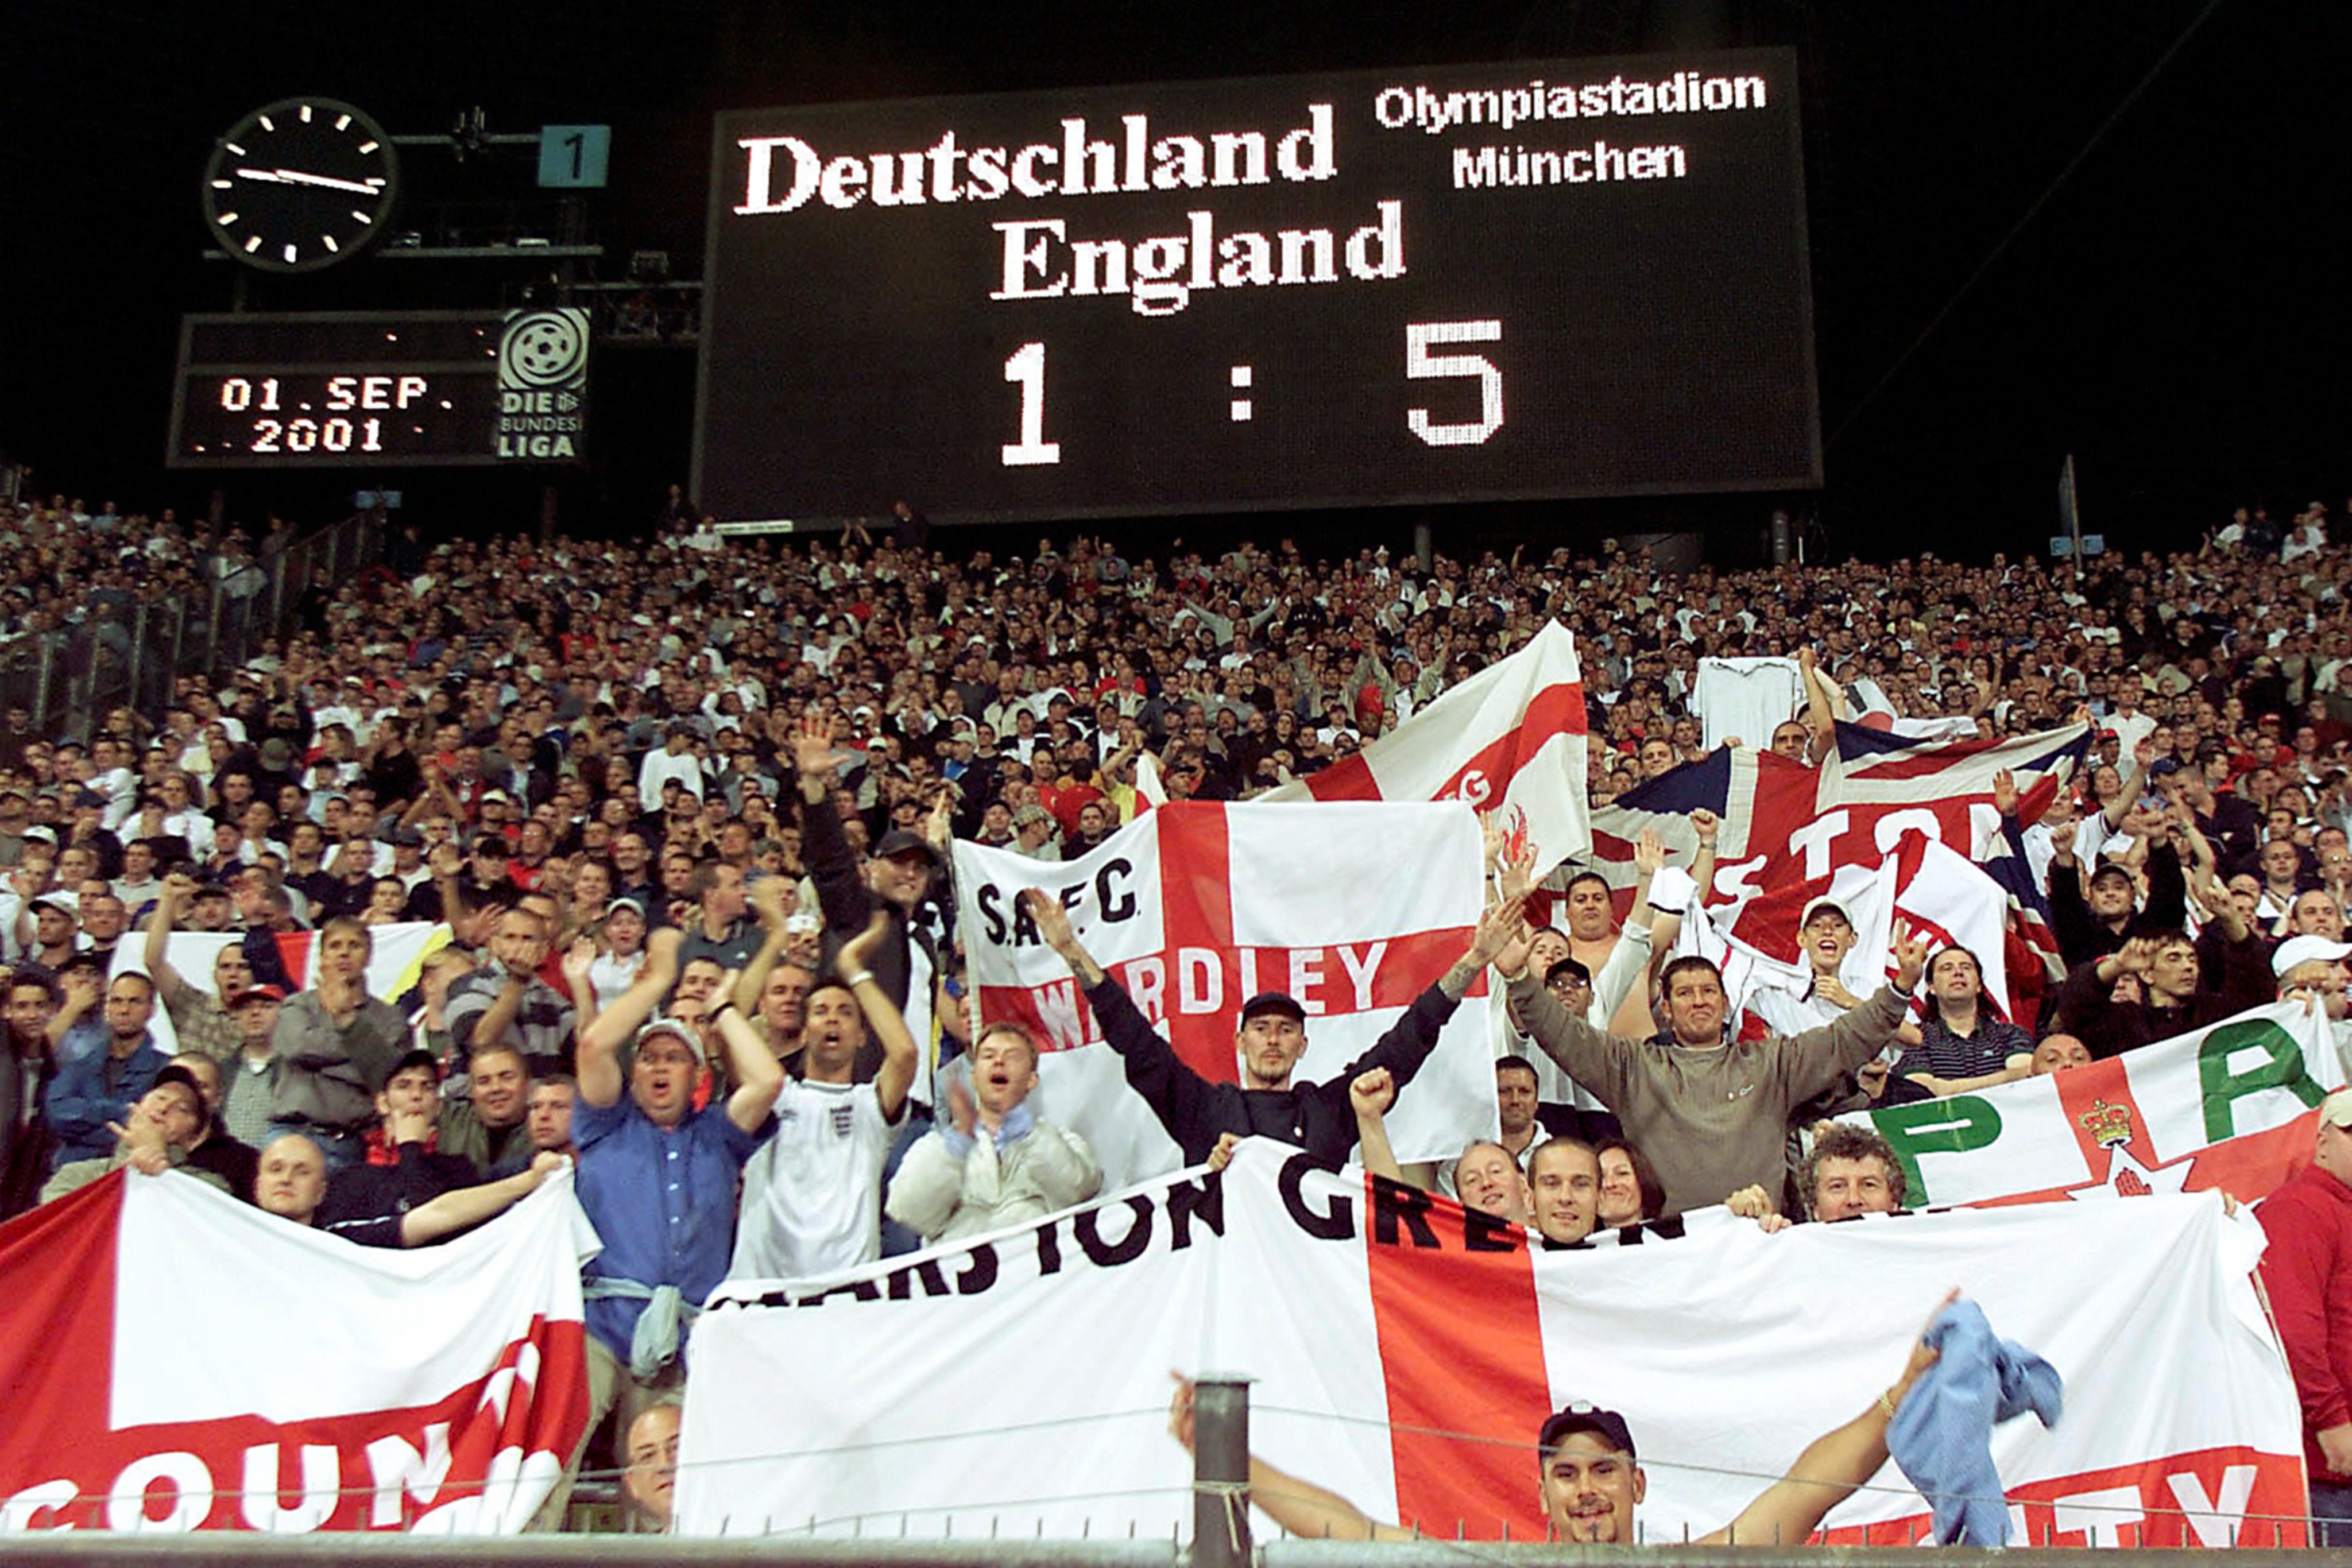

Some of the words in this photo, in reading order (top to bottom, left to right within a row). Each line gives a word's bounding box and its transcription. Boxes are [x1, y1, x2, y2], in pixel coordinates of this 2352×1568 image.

[1376, 72, 1765, 134] Olympiastadion
[565, 133, 583, 179] 1
[734, 104, 1337, 216] Deutschland
[1453, 141, 1686, 188] München
[991, 200, 1406, 316] England
[502, 392, 552, 413] DIE
[1003, 343, 1059, 465] 1
[1232, 366, 1252, 421] :
[1407, 320, 1503, 446] 5
[252, 419, 381, 452] 2001
[498, 435, 574, 457] LIGA
[500, 417, 578, 432] BUNDES
[1034, 942, 1388, 1050] WRDLEY
[1278, 1153, 1686, 1252] GRE
[0, 1367, 517, 1532] COUN
